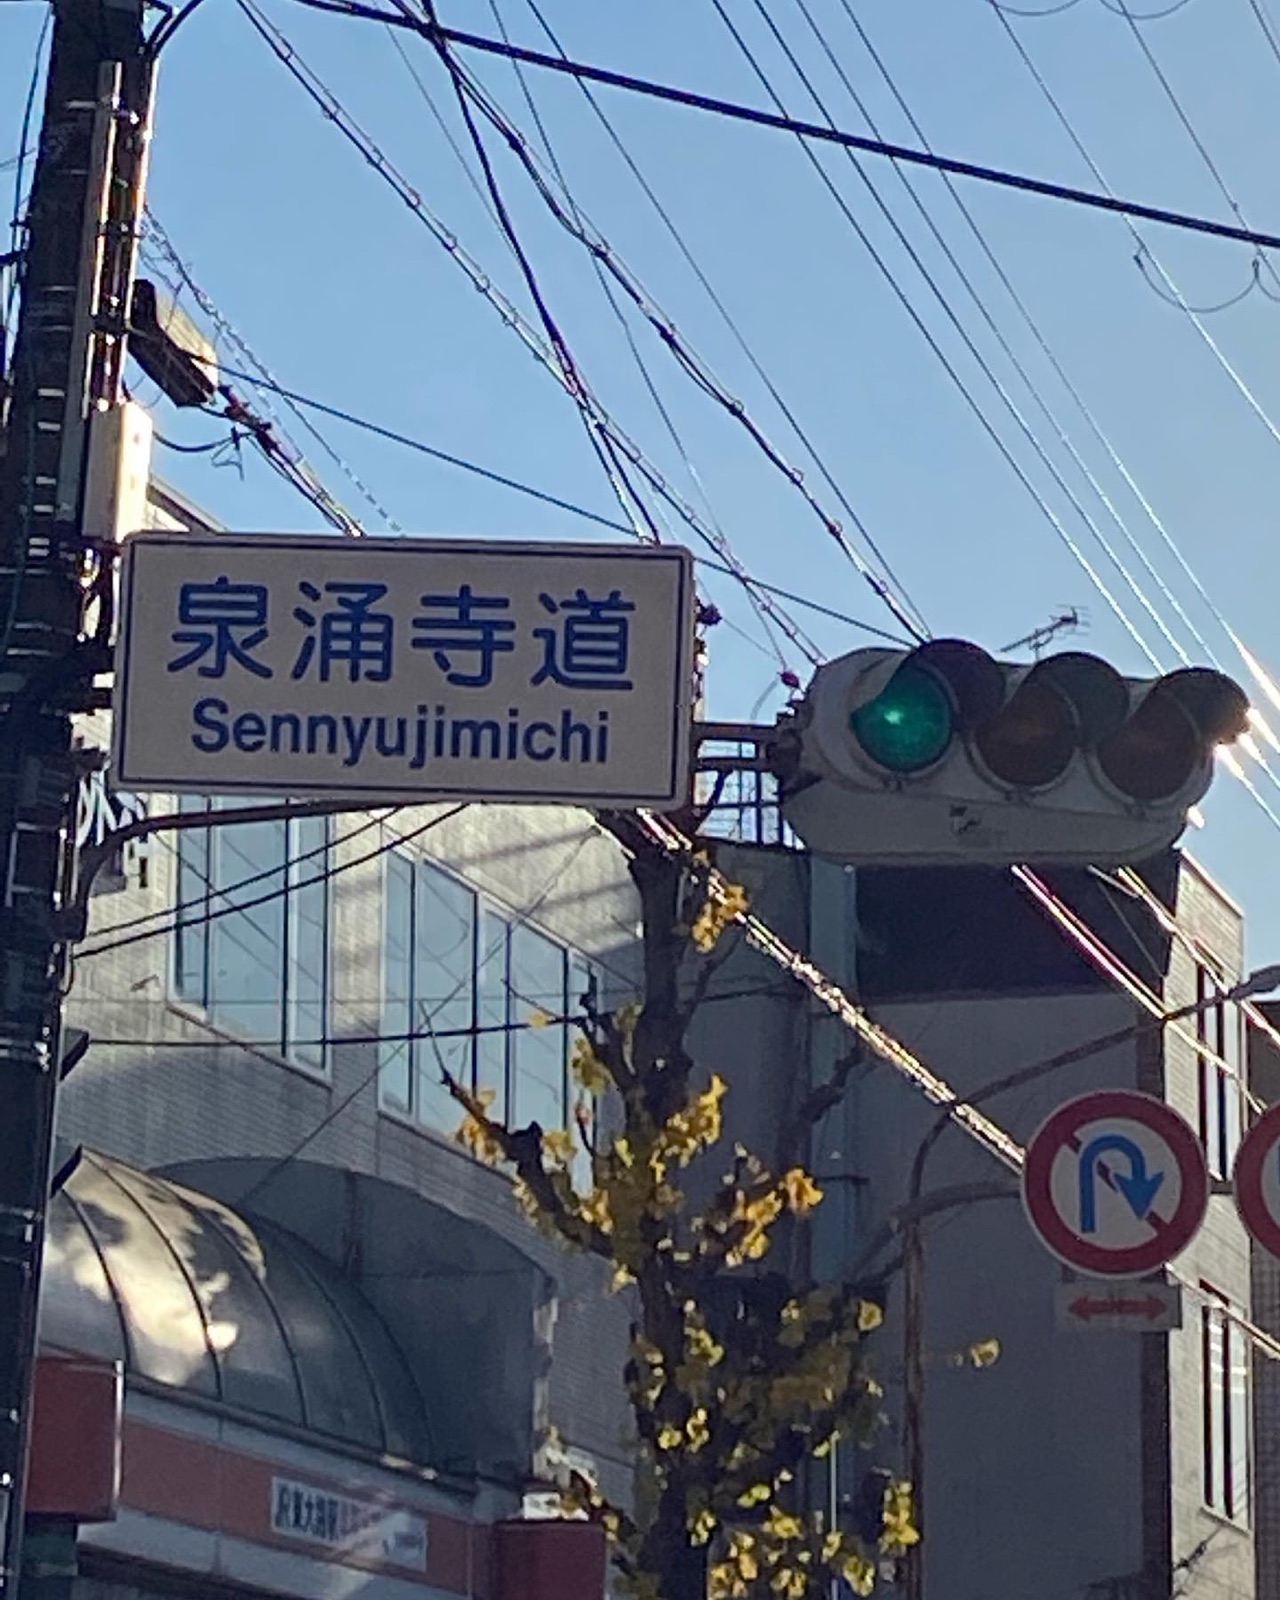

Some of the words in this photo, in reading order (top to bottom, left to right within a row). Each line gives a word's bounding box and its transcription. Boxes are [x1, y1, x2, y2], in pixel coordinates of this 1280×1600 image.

[167, 575, 636, 691] 泉涌寺道
[191, 697, 610, 769] Sennyujimichi
